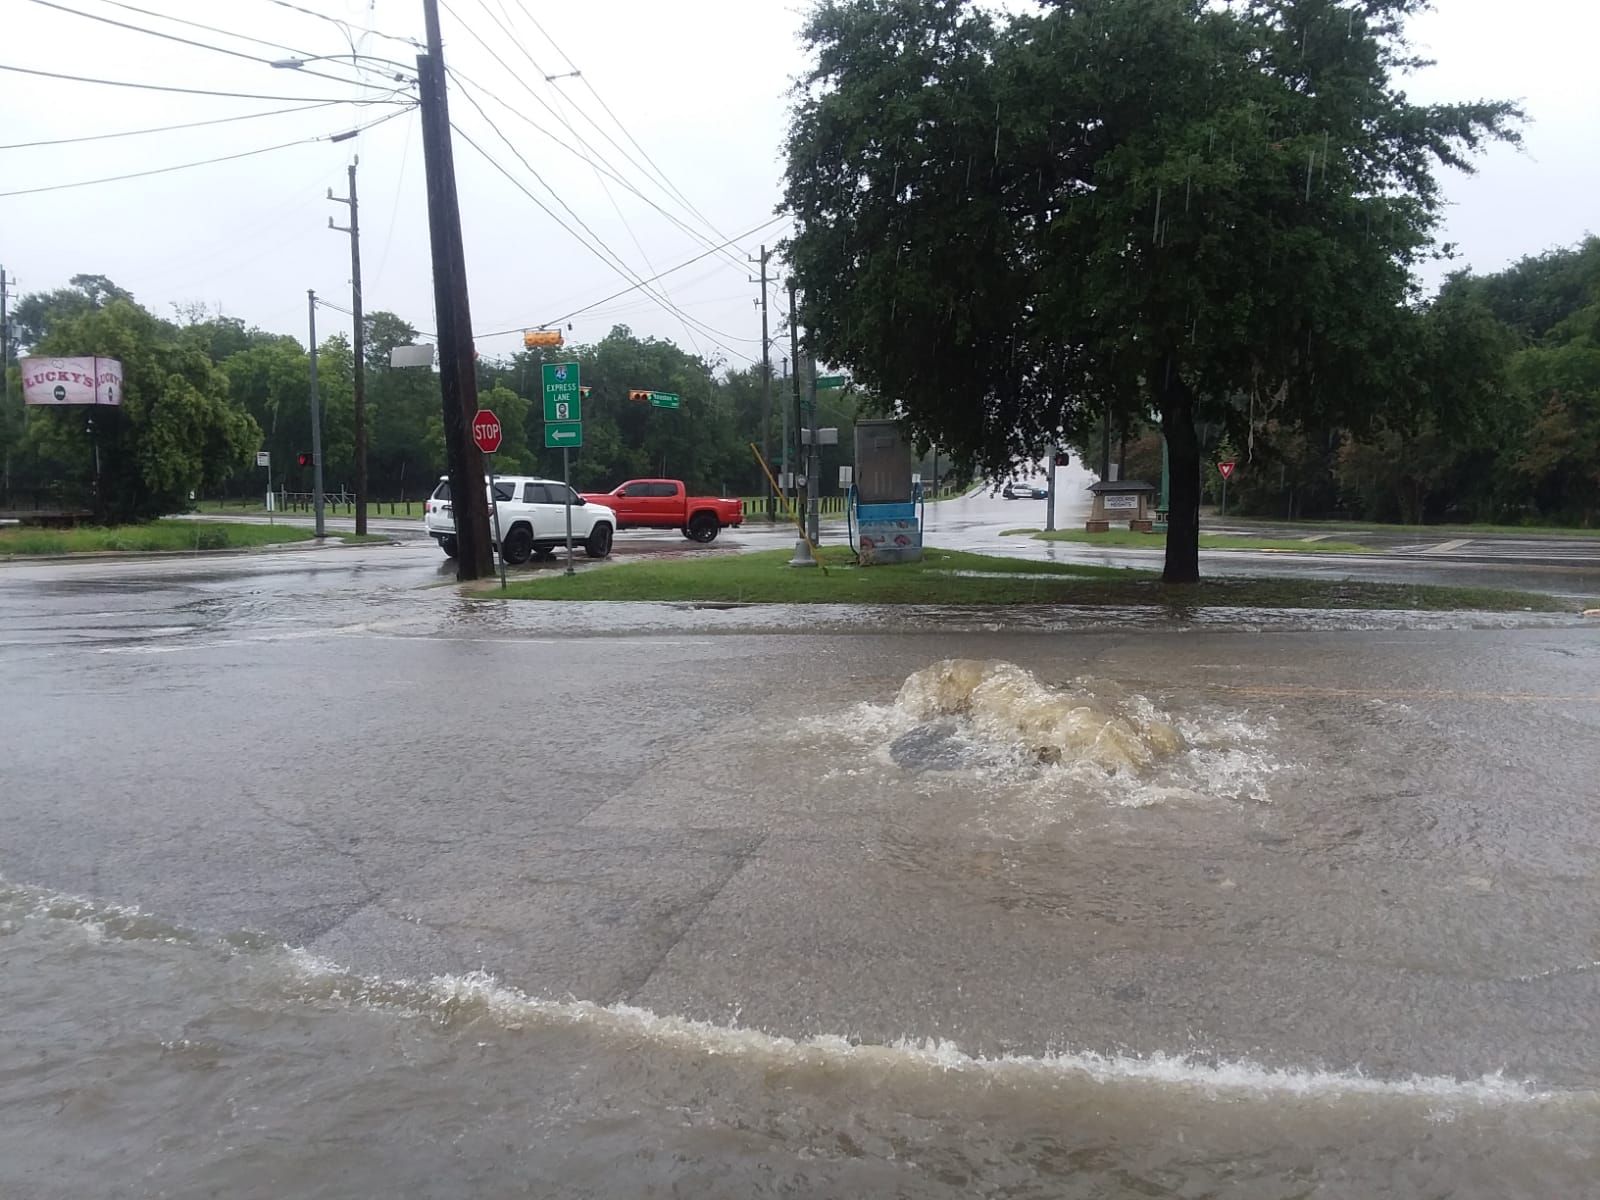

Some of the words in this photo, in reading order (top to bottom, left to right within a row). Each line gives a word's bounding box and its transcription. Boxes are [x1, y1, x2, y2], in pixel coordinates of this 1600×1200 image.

[556, 368, 567, 378] 45
[25, 371, 93, 388] LUCKY'S
[546, 383, 577, 392] EXPRESS
[553, 392, 571, 402] LANE
[475, 424, 499, 440] STOP
